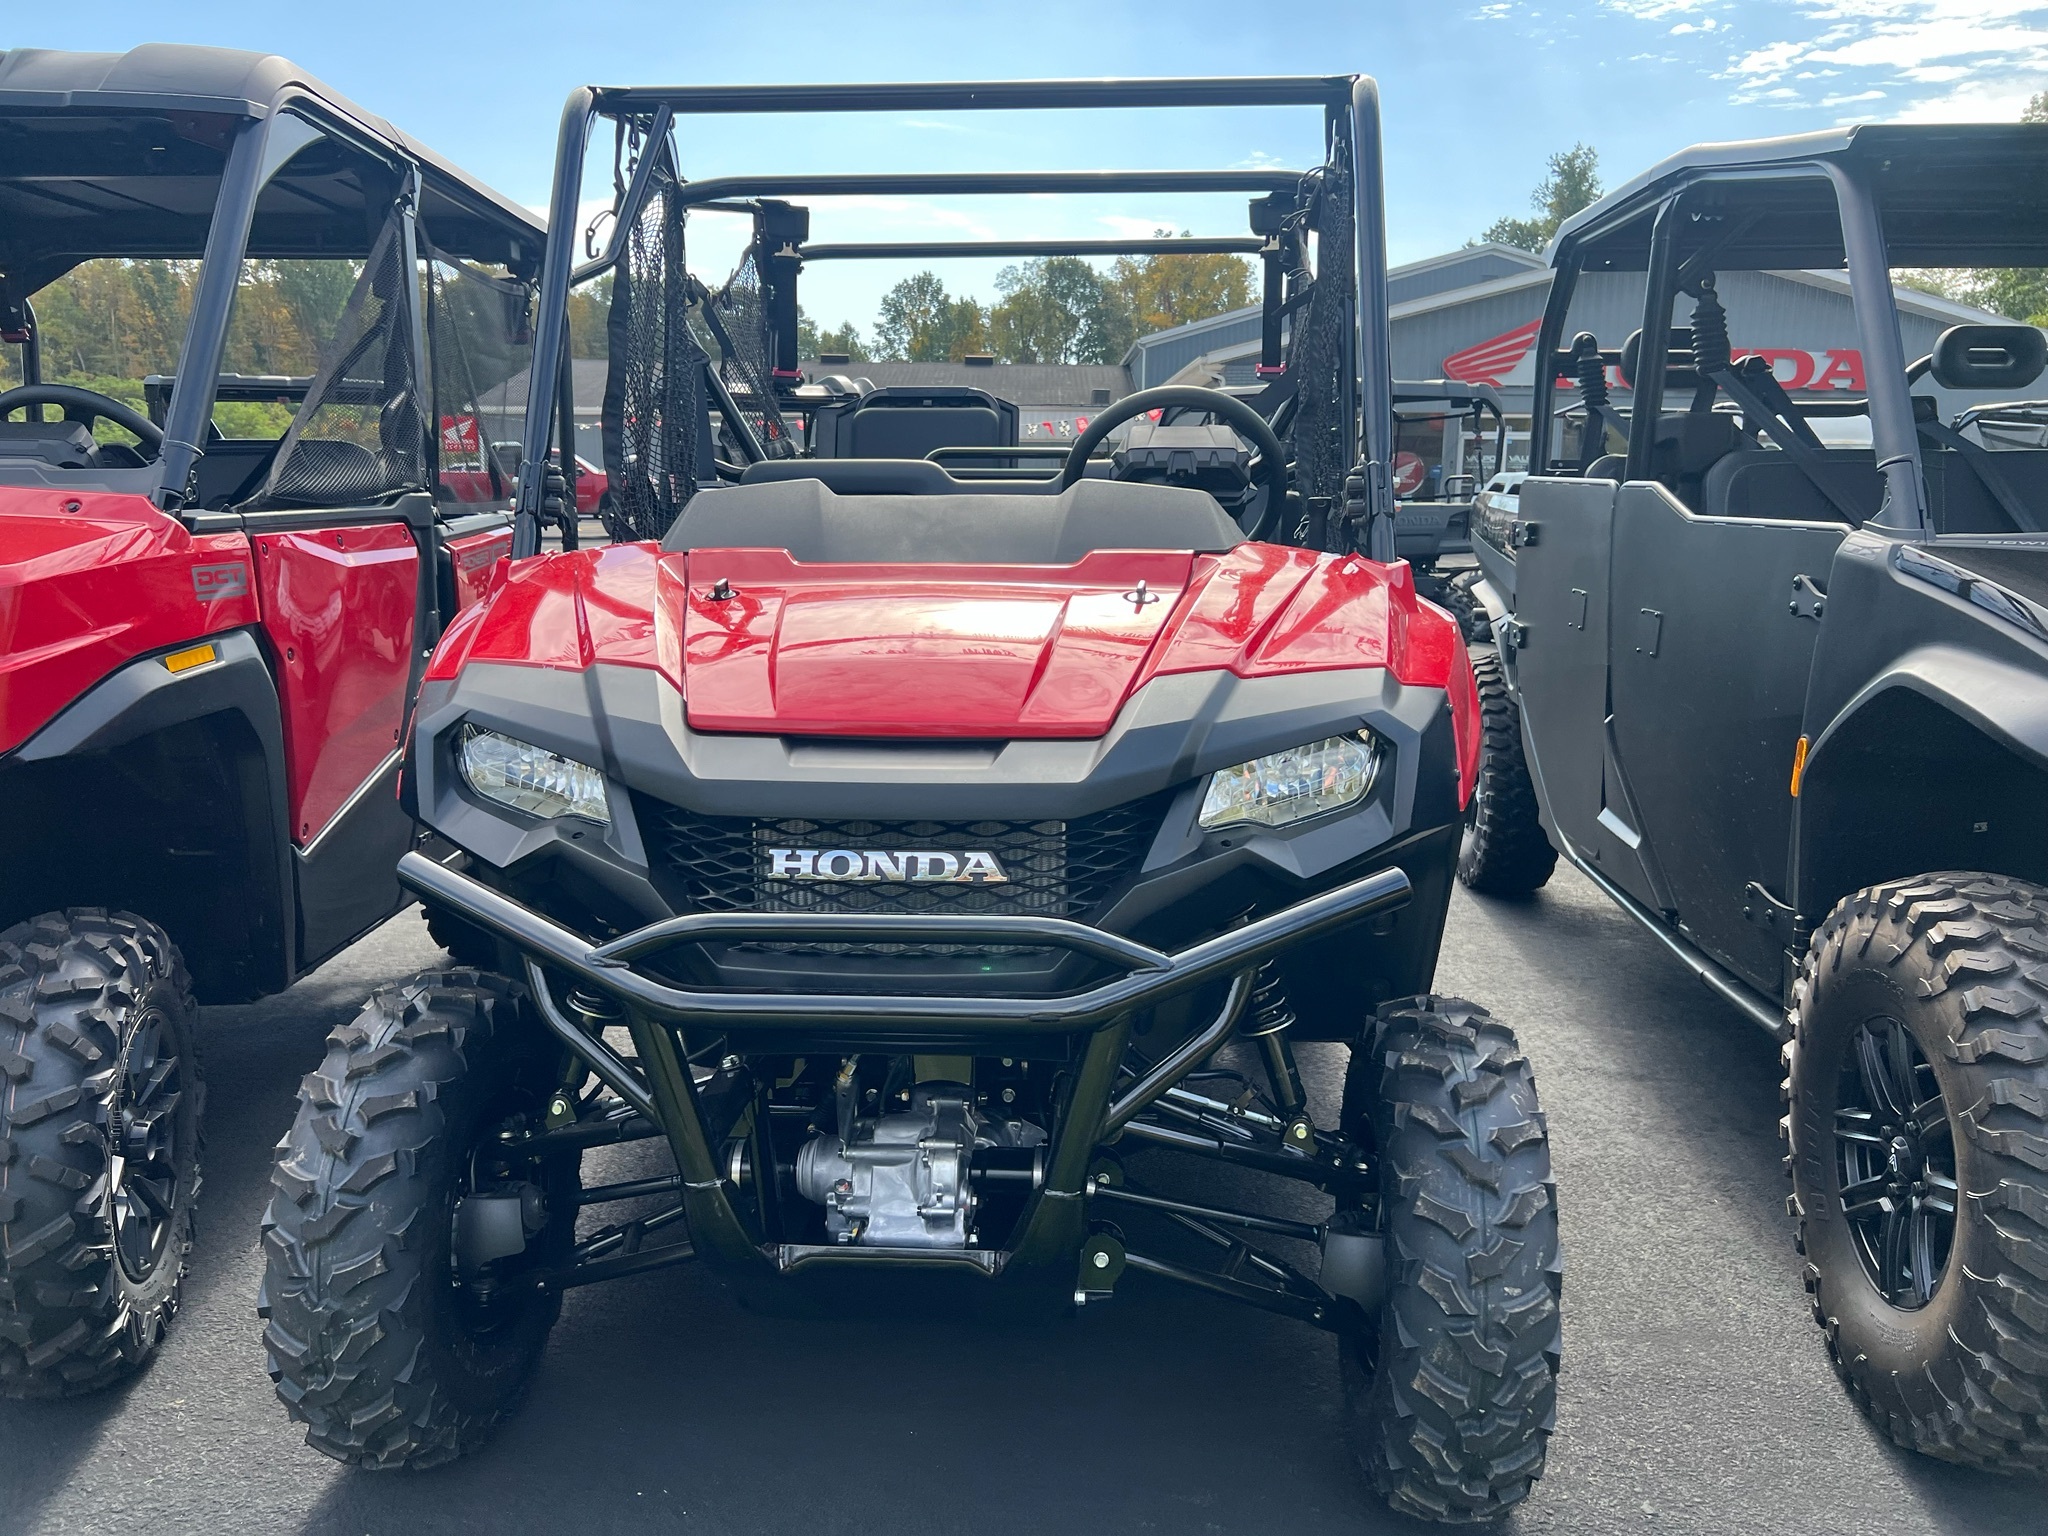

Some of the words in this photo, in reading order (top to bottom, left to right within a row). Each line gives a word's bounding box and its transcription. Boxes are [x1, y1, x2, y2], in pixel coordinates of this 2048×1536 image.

[1395, 515, 1442, 526] ONDA
[196, 567, 243, 586] DCT
[767, 849, 1008, 882] HONDA
